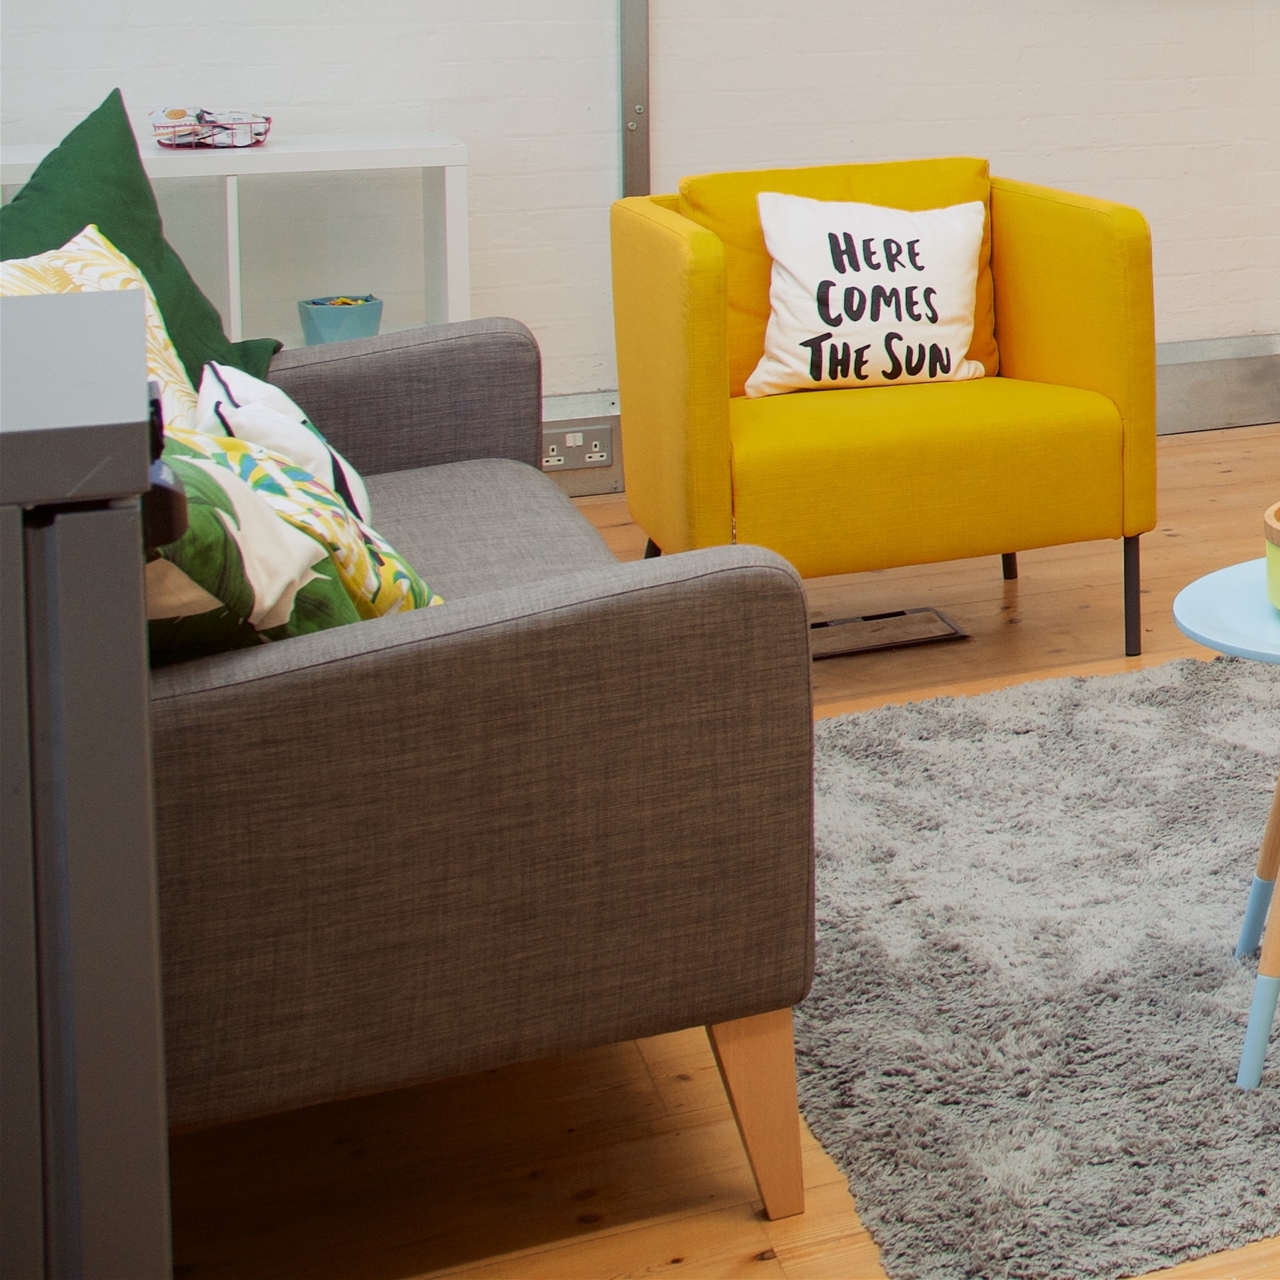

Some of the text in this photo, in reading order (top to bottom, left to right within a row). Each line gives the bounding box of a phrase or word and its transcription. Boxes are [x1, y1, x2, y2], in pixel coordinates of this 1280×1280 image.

[828, 231, 925, 274] HERE
[816, 279, 939, 328] COMES
[799, 331, 952, 382] THE SUN
